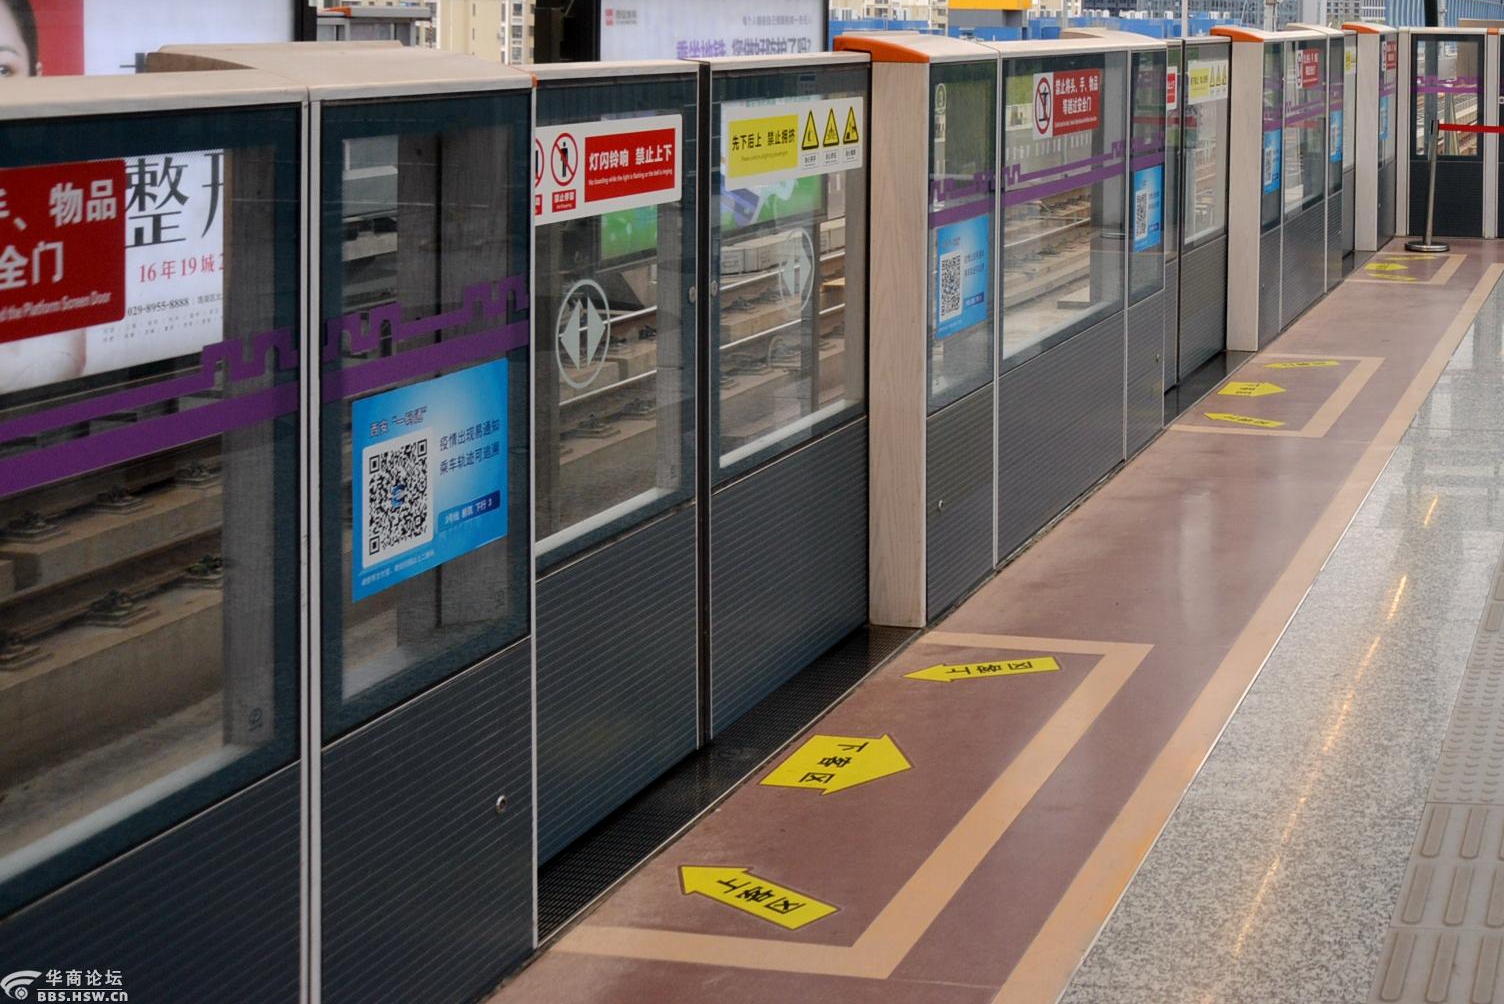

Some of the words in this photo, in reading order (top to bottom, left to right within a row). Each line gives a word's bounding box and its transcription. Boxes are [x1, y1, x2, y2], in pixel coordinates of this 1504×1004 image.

[732, 132, 762, 152] 先下后上
[589, 148, 629, 172] 灯闪铃响
[635, 143, 673, 166] 禁止上下
[22, 299, 61, 317] Platform
[61, 295, 90, 311] Screen
[90, 290, 112, 306] Door
[439, 419, 500, 452] 疫情出现易通知
[945, 661, 1033, 676] 上客区
[799, 741, 869, 784] 下客区
[717, 877, 802, 915] 上客区
